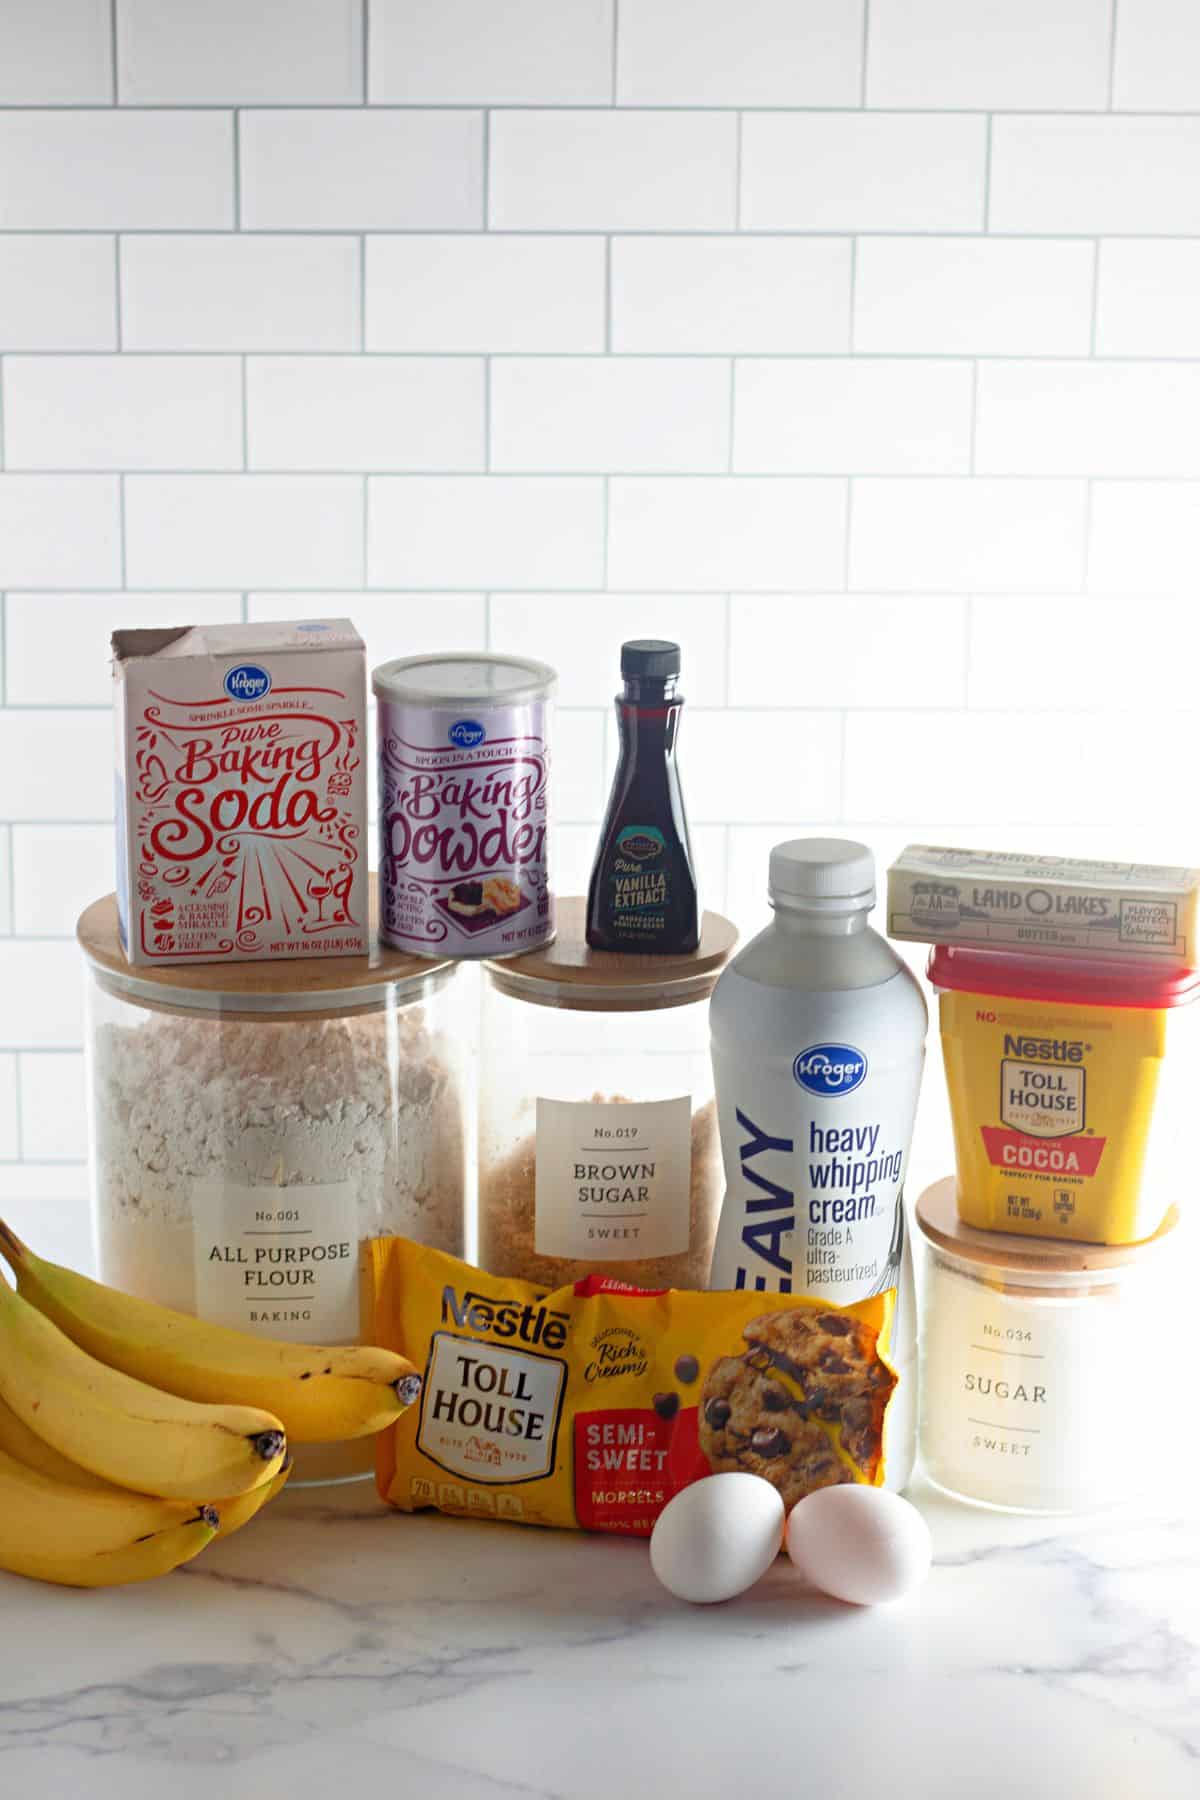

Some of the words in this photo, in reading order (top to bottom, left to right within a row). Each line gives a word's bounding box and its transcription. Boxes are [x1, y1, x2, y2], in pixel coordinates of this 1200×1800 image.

[231, 671, 265, 695] Kroger
[189, 707, 234, 722] SPRINKLE
[221, 723, 282, 749] Pure
[451, 725, 482, 744] Kroger
[174, 734, 321, 785] Baking
[406, 772, 534, 821] Baking
[150, 772, 338, 861] Soda
[385, 808, 546, 886] Powder
[615, 873, 666, 892] VANILLA
[614, 887, 666, 908] EXTRACT
[972, 887, 1023, 909] LAND
[1025, 889, 1053, 915] O
[1056, 894, 1109, 916] LAKES
[1124, 914, 1170, 926] PROTECT
[1127, 905, 1168, 917] FLAVOR
[799, 1054, 863, 1086] Kroger
[1019, 1069, 1068, 1092] TOLL
[1009, 1089, 1078, 1112] HOUSE
[593, 1127, 639, 1139] No.019
[809, 1120, 881, 1158] heavy
[1002, 1144, 1080, 1171] COCOA
[573, 1162, 656, 1181] BROWN
[808, 1149, 904, 1195] whipping
[578, 1187, 649, 1203] SUGAR
[735, 1107, 795, 1294] EAVY
[255, 1210, 300, 1222] No.001
[808, 1193, 876, 1225] cream
[588, 1228, 641, 1239] SWEET
[807, 1228, 842, 1247] Grade
[845, 1229, 853, 1243] A
[208, 1245, 248, 1264] ALL
[255, 1242, 351, 1264] PURPOSE
[806, 1247, 841, 1265] ultra-
[244, 1269, 316, 1286] FLOUR
[806, 1258, 878, 1287] pasteurized
[250, 1310, 312, 1322] BAKING
[597, 1340, 639, 1364] Rich
[456, 1355, 533, 1400] TOLL
[583, 1360, 649, 1384] Creamy
[963, 1372, 1047, 1404] SUGAR
[432, 1389, 545, 1441] HOUSE
[586, 1423, 656, 1445] SEMI-
[973, 1435, 1031, 1457] SWEET
[586, 1448, 668, 1471] SWEET
[591, 1490, 665, 1505] MORSELS
